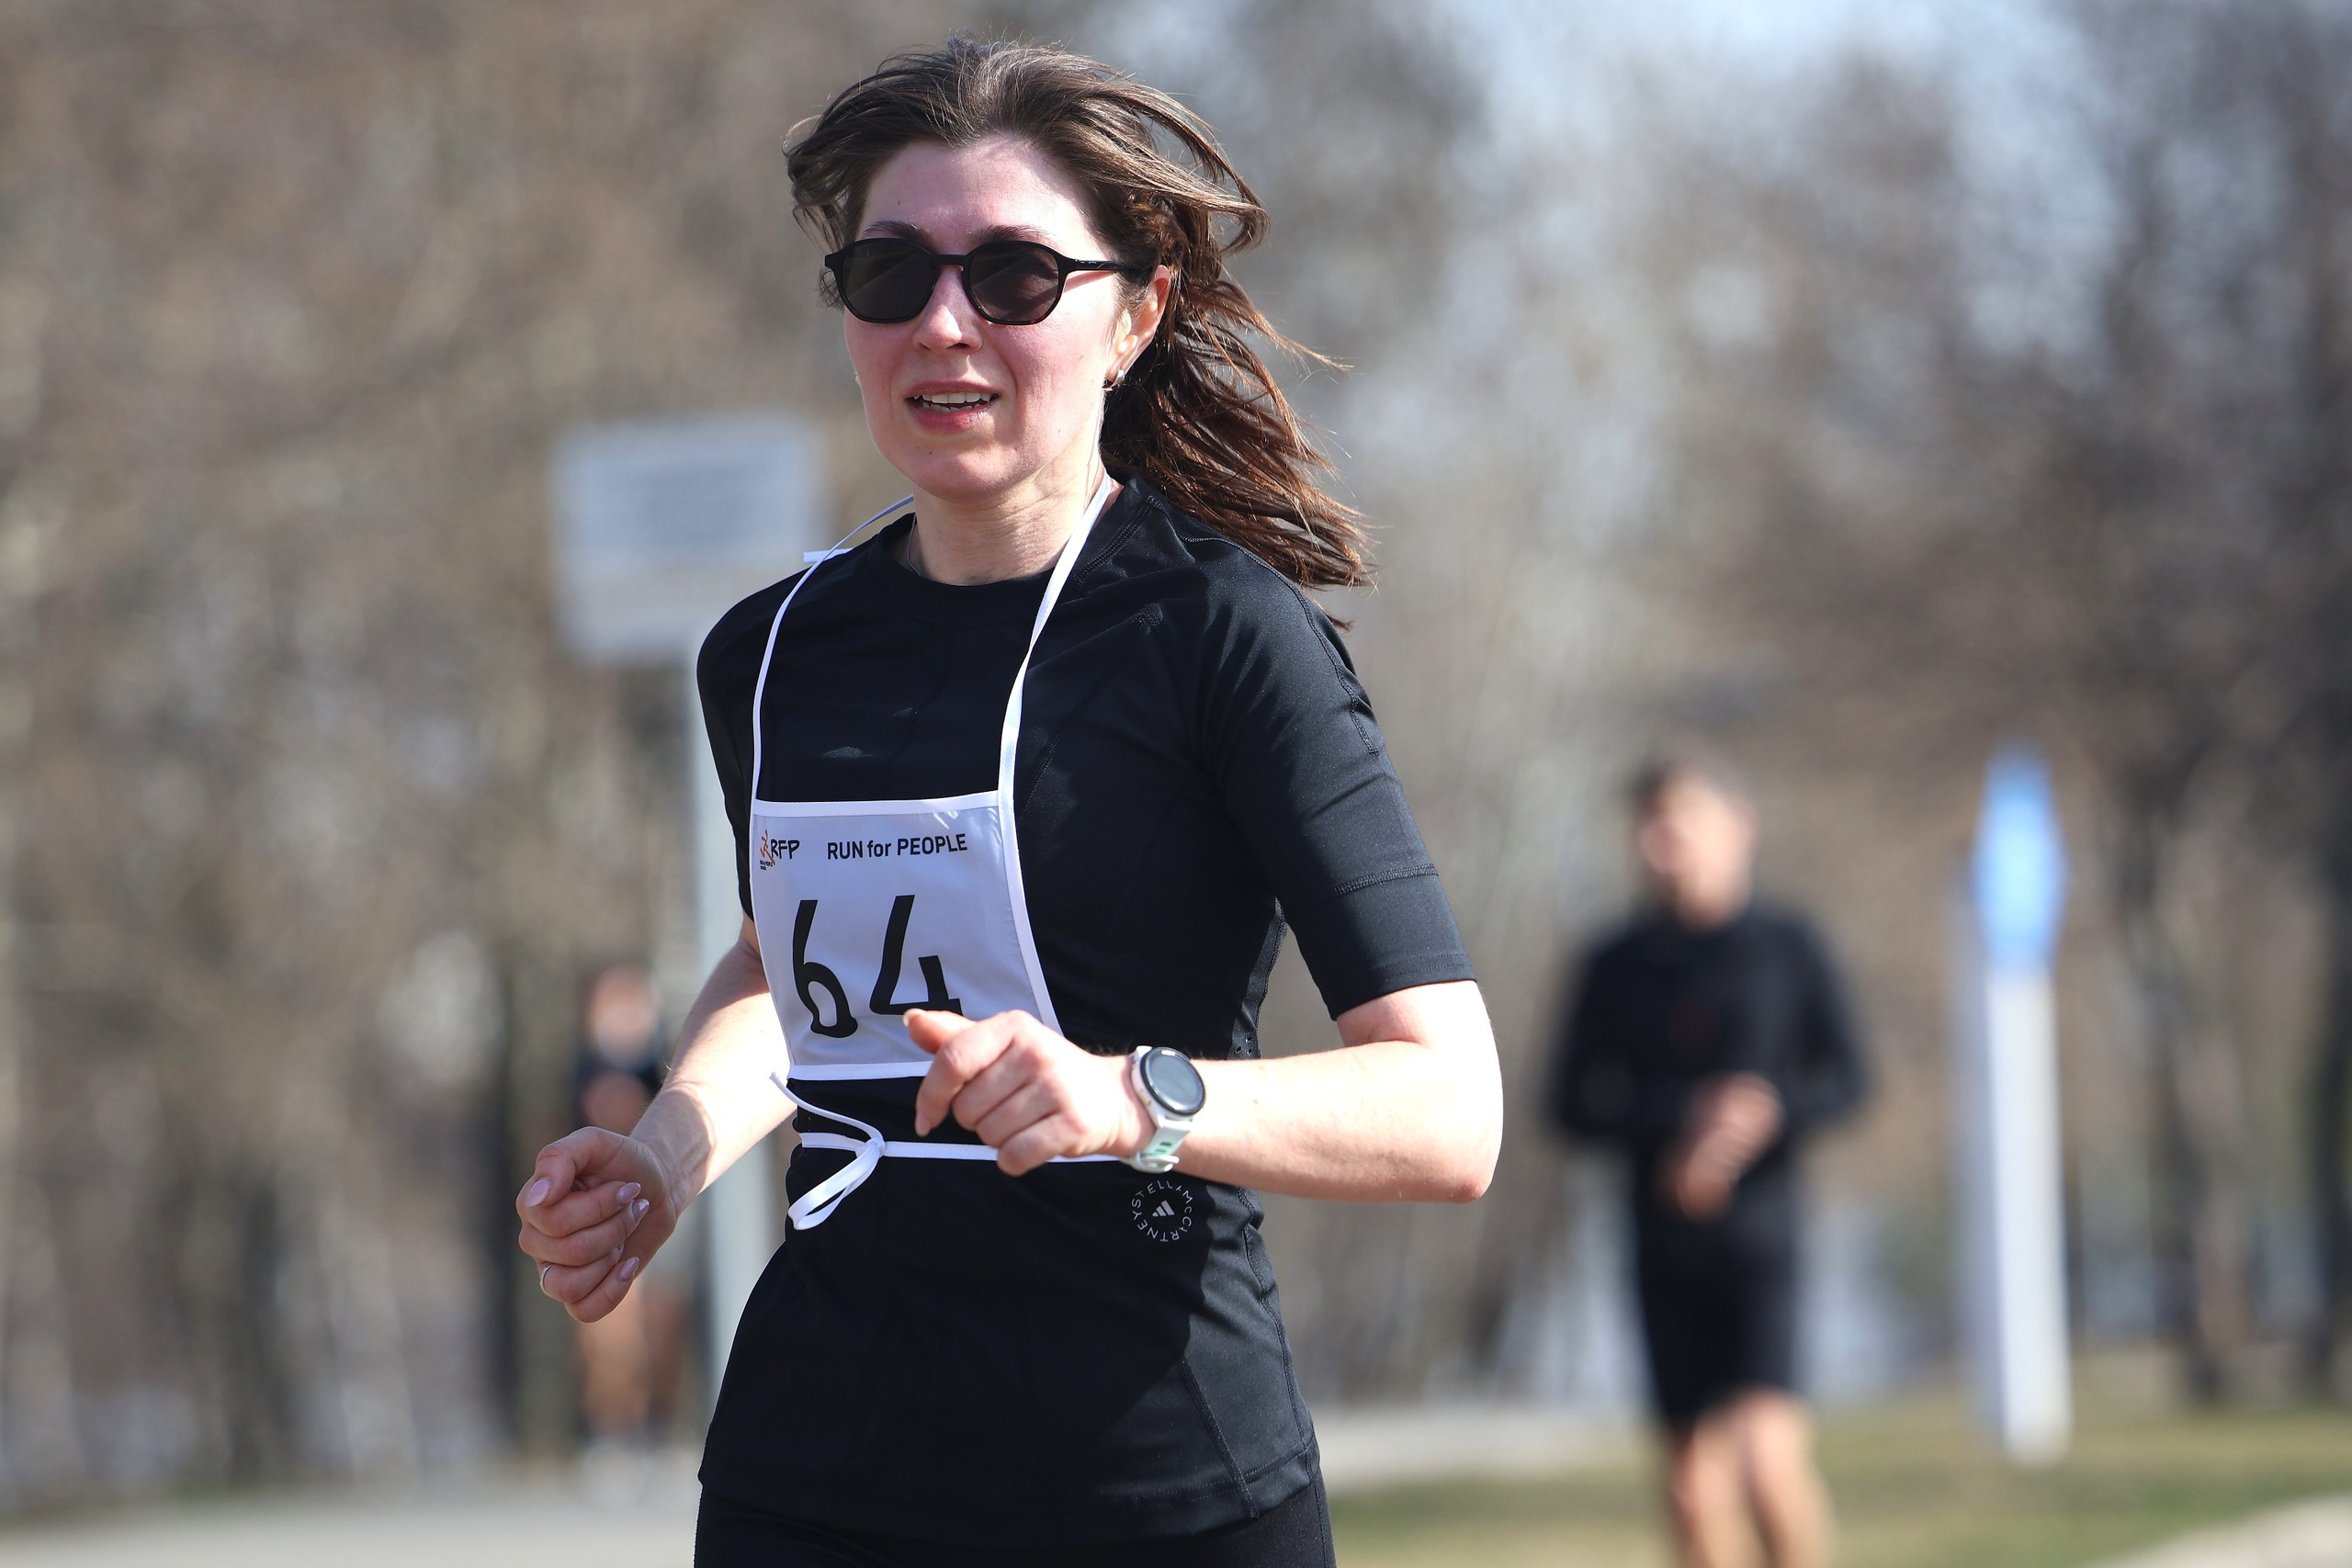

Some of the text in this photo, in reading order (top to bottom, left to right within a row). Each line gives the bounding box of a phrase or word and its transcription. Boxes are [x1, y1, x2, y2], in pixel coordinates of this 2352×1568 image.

[771, 839, 800, 860] RFP
[827, 833, 968, 860] RUN for PEOPLE
[792, 894, 964, 1039] 64
